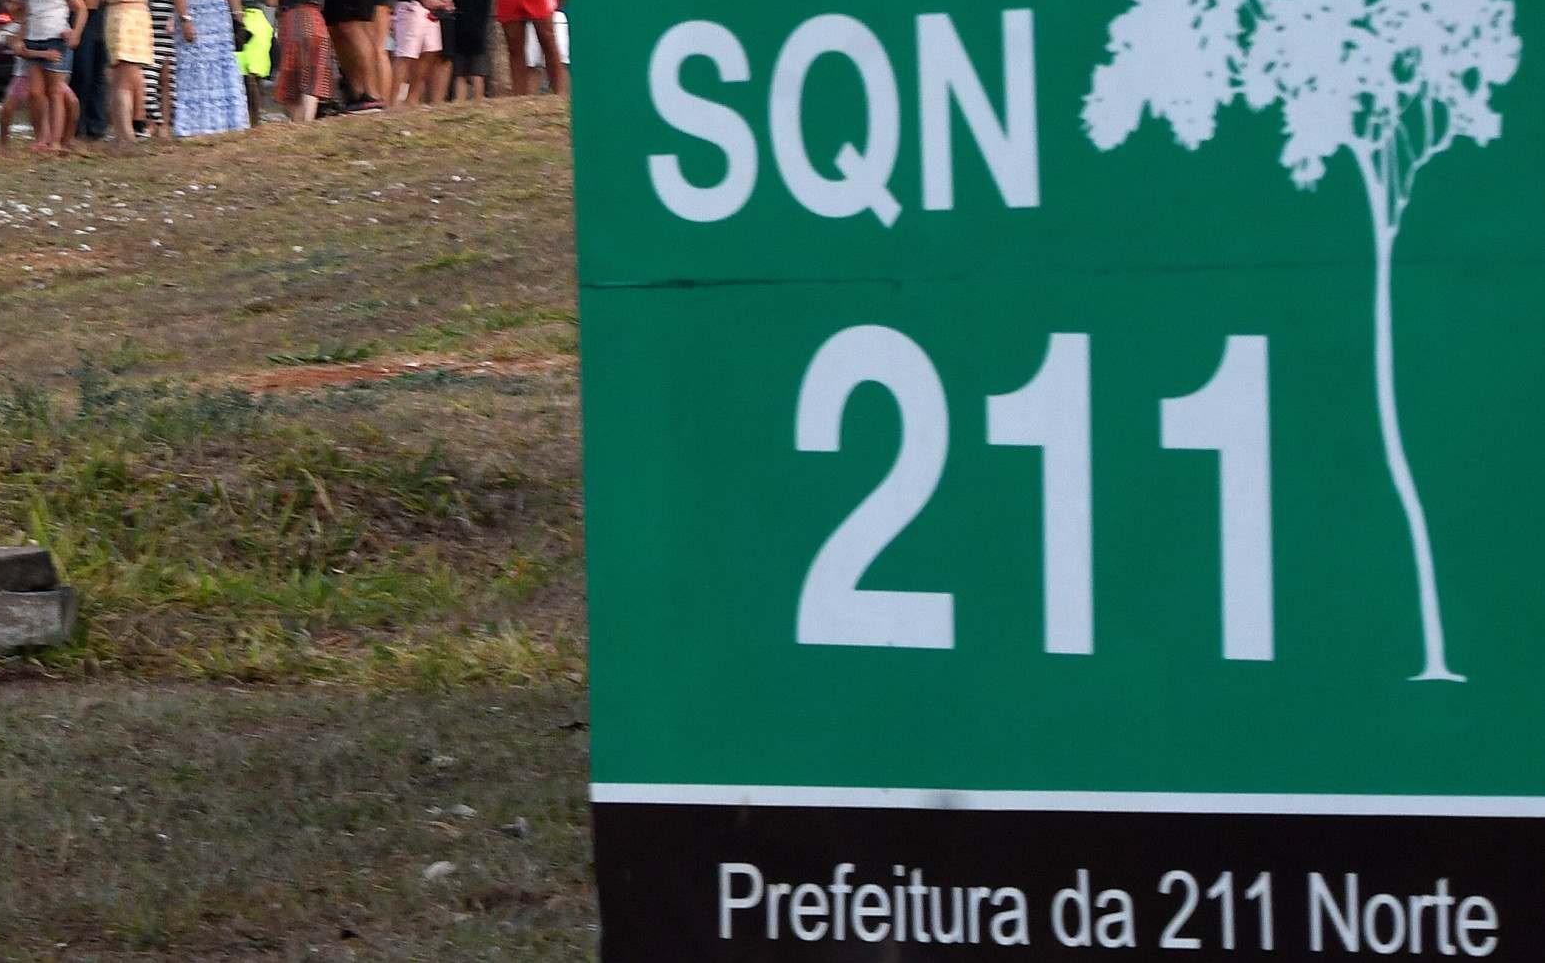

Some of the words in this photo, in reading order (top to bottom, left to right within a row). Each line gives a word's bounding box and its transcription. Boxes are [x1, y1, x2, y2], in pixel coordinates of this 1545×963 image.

[648, 8, 1040, 227] SQN
[795, 323, 1274, 662] 211
[718, 861, 1031, 947] Prefeitura
[1051, 868, 1138, 949] da
[1158, 869, 1275, 951] 211
[1308, 871, 1499, 958] Norte
